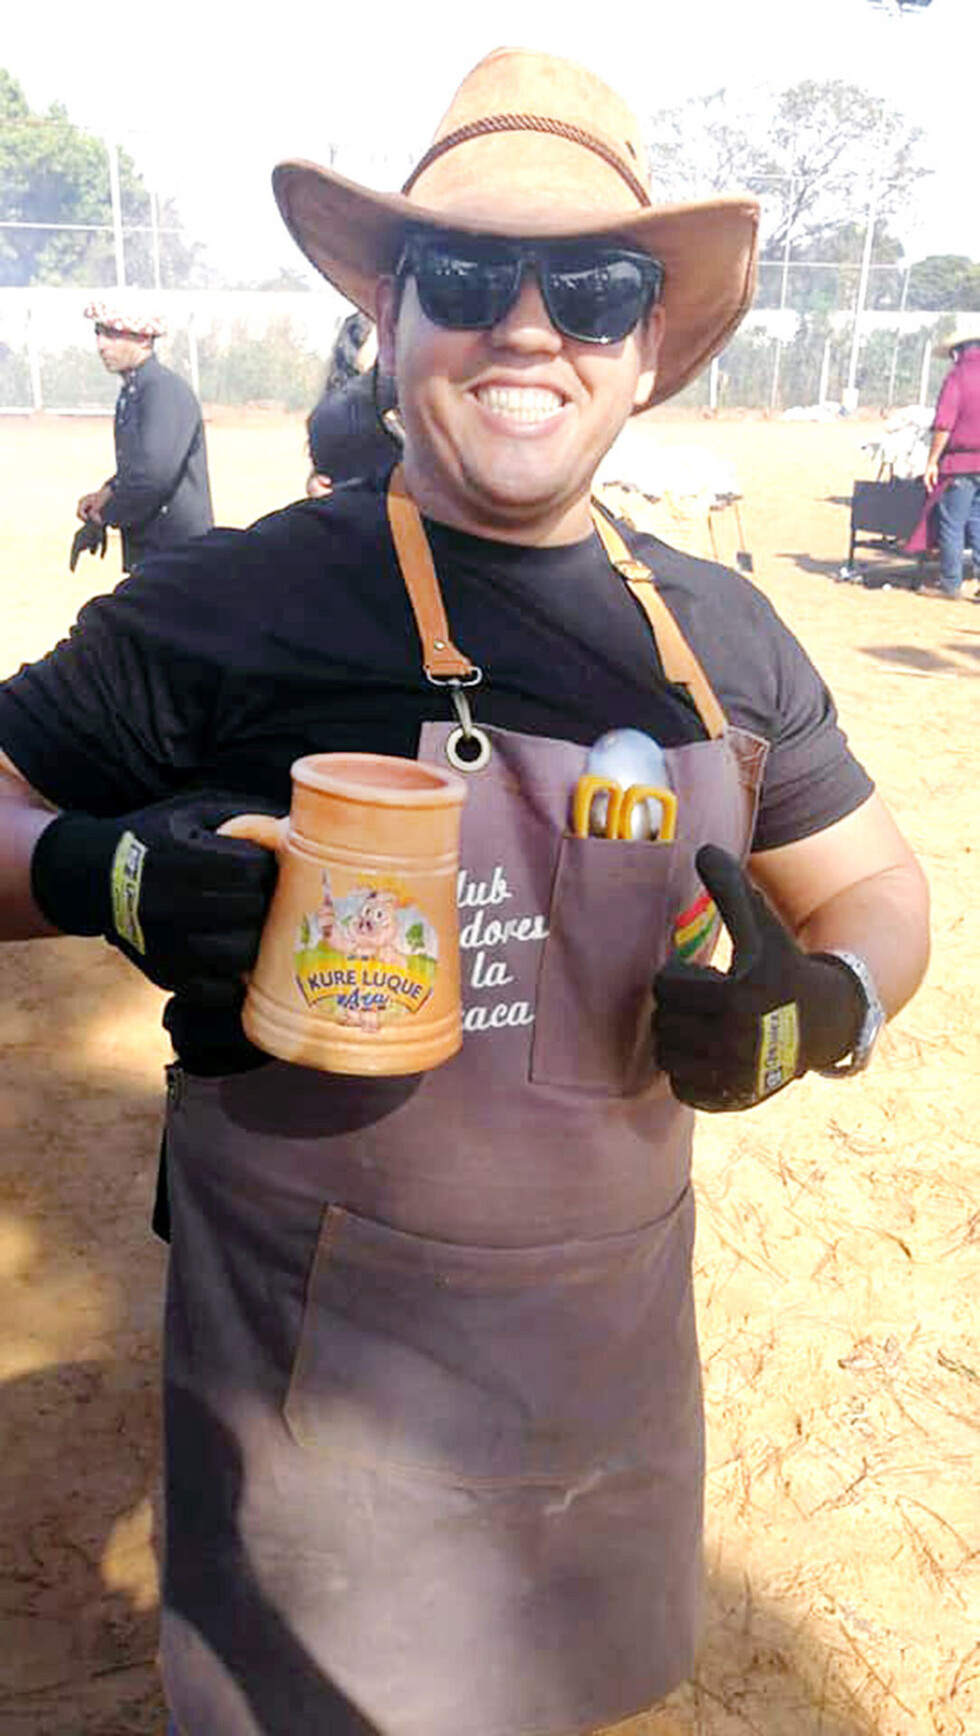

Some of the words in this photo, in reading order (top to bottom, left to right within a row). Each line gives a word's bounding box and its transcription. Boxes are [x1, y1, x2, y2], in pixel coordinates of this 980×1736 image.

[457, 867, 512, 908] lub
[459, 910, 550, 949] dores
[308, 969, 357, 991] KURE
[361, 969, 423, 1000] LUQUE
[470, 951, 514, 988] la
[462, 1001, 535, 1031] aca
